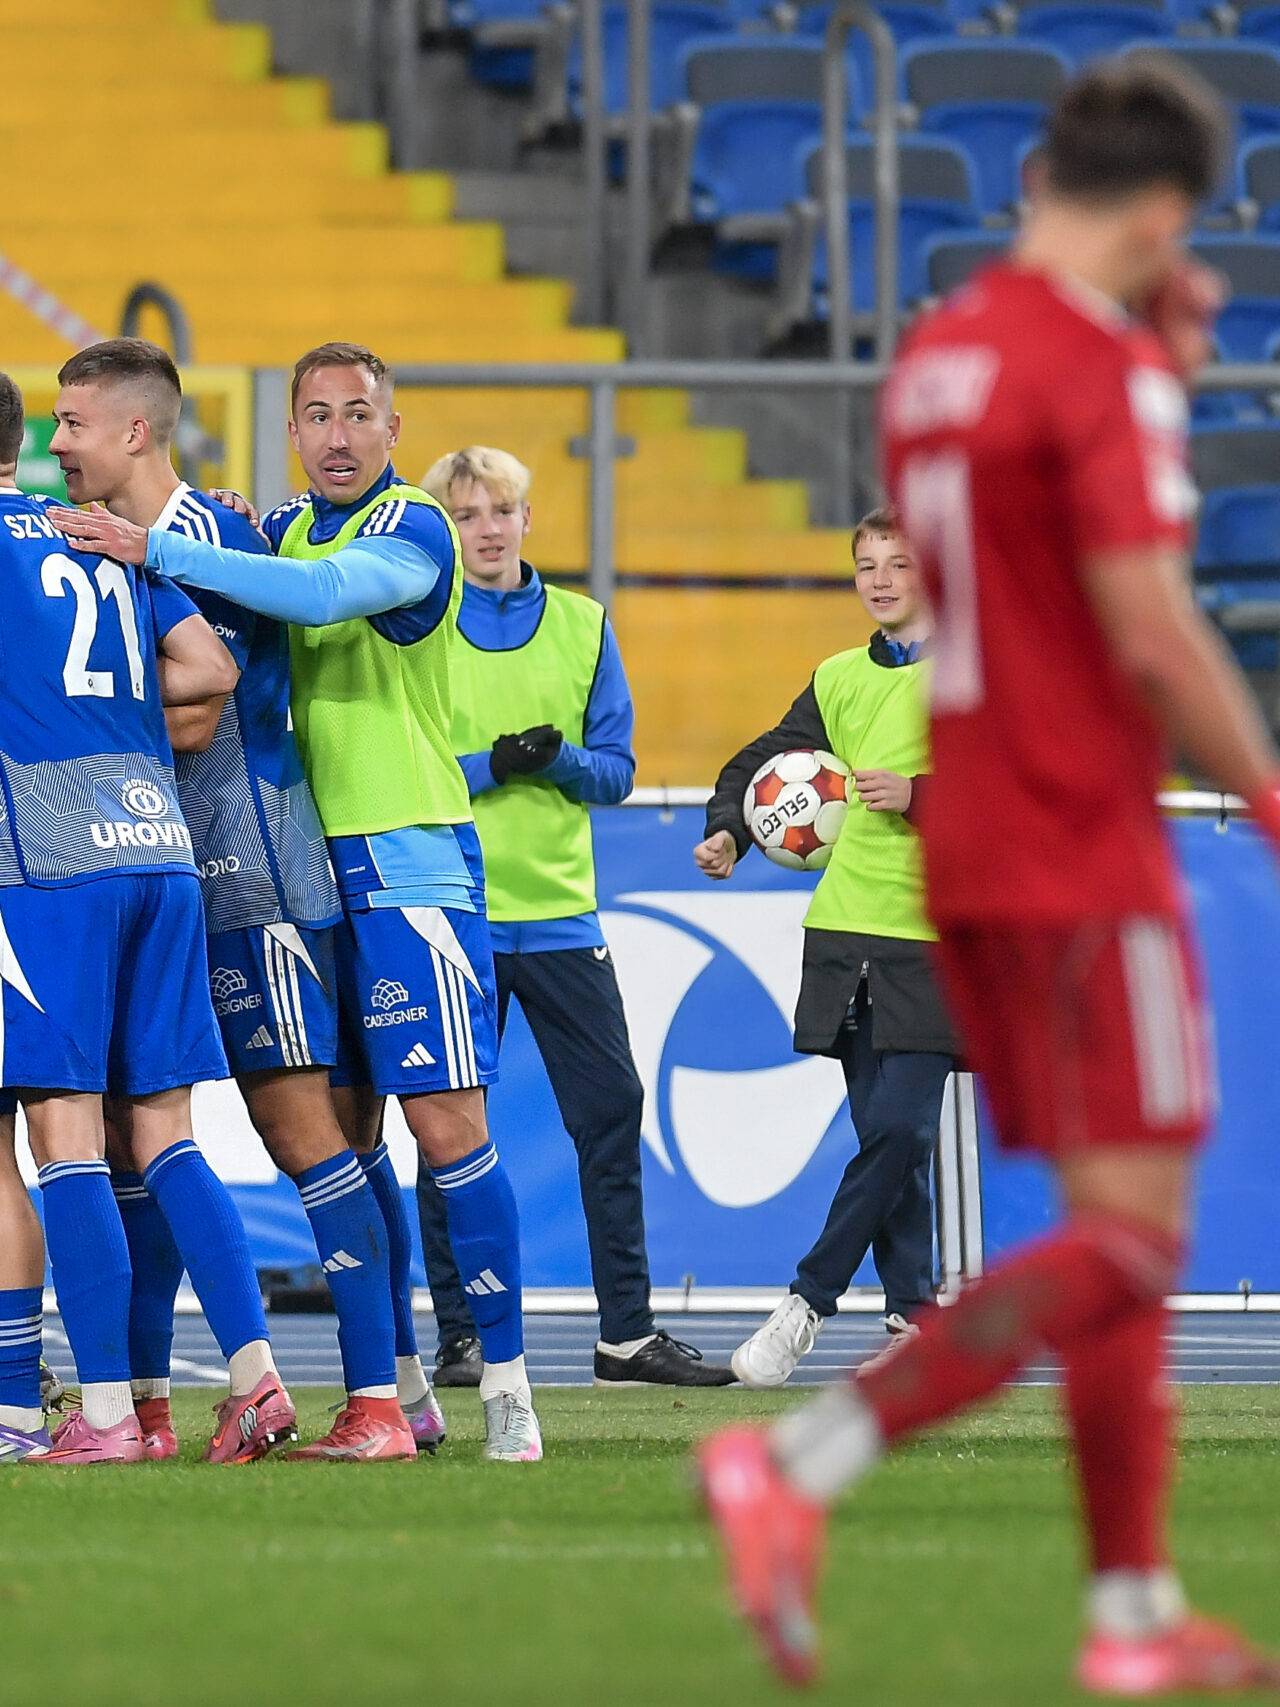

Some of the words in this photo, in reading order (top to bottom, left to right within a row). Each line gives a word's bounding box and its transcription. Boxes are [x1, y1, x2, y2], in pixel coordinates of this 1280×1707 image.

[4, 514, 84, 541] SZW
[41, 553, 145, 701] 21
[210, 623, 237, 639] ÓW
[757, 791, 809, 840] SELECT
[363, 1006, 429, 1028] CADESIGNER
